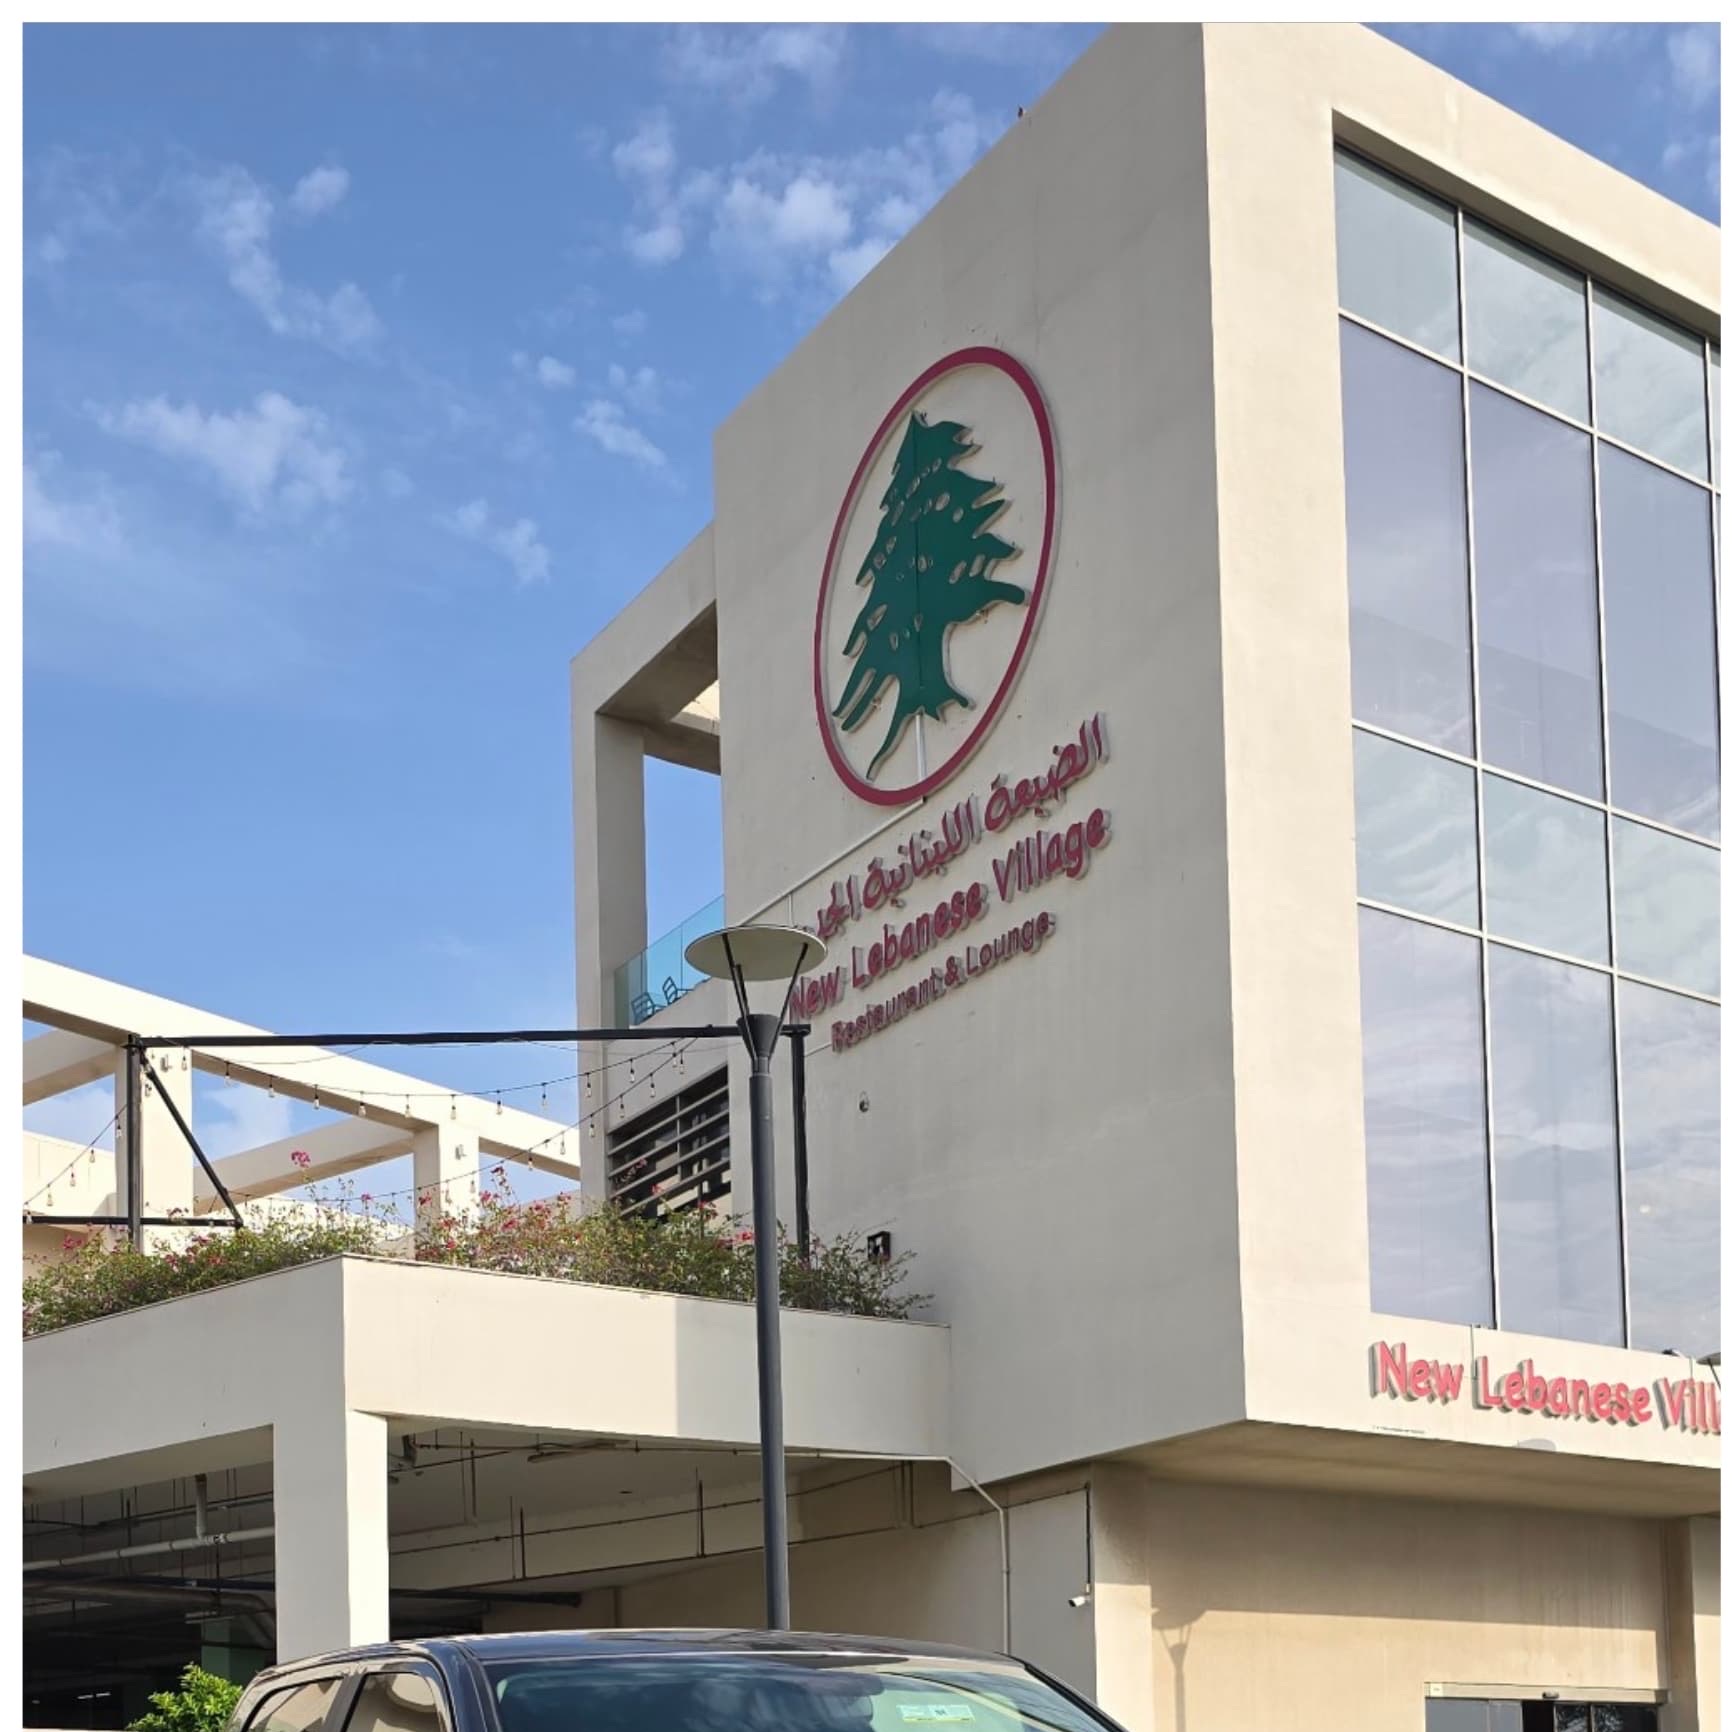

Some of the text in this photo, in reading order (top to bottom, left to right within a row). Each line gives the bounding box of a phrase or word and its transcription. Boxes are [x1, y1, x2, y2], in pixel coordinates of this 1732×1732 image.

[790, 808, 1111, 1024] New Lebanese Village
[832, 912, 1055, 1052] Restaurant & Lounge
[1371, 1341, 1720, 1434] New Lebanese Vill
